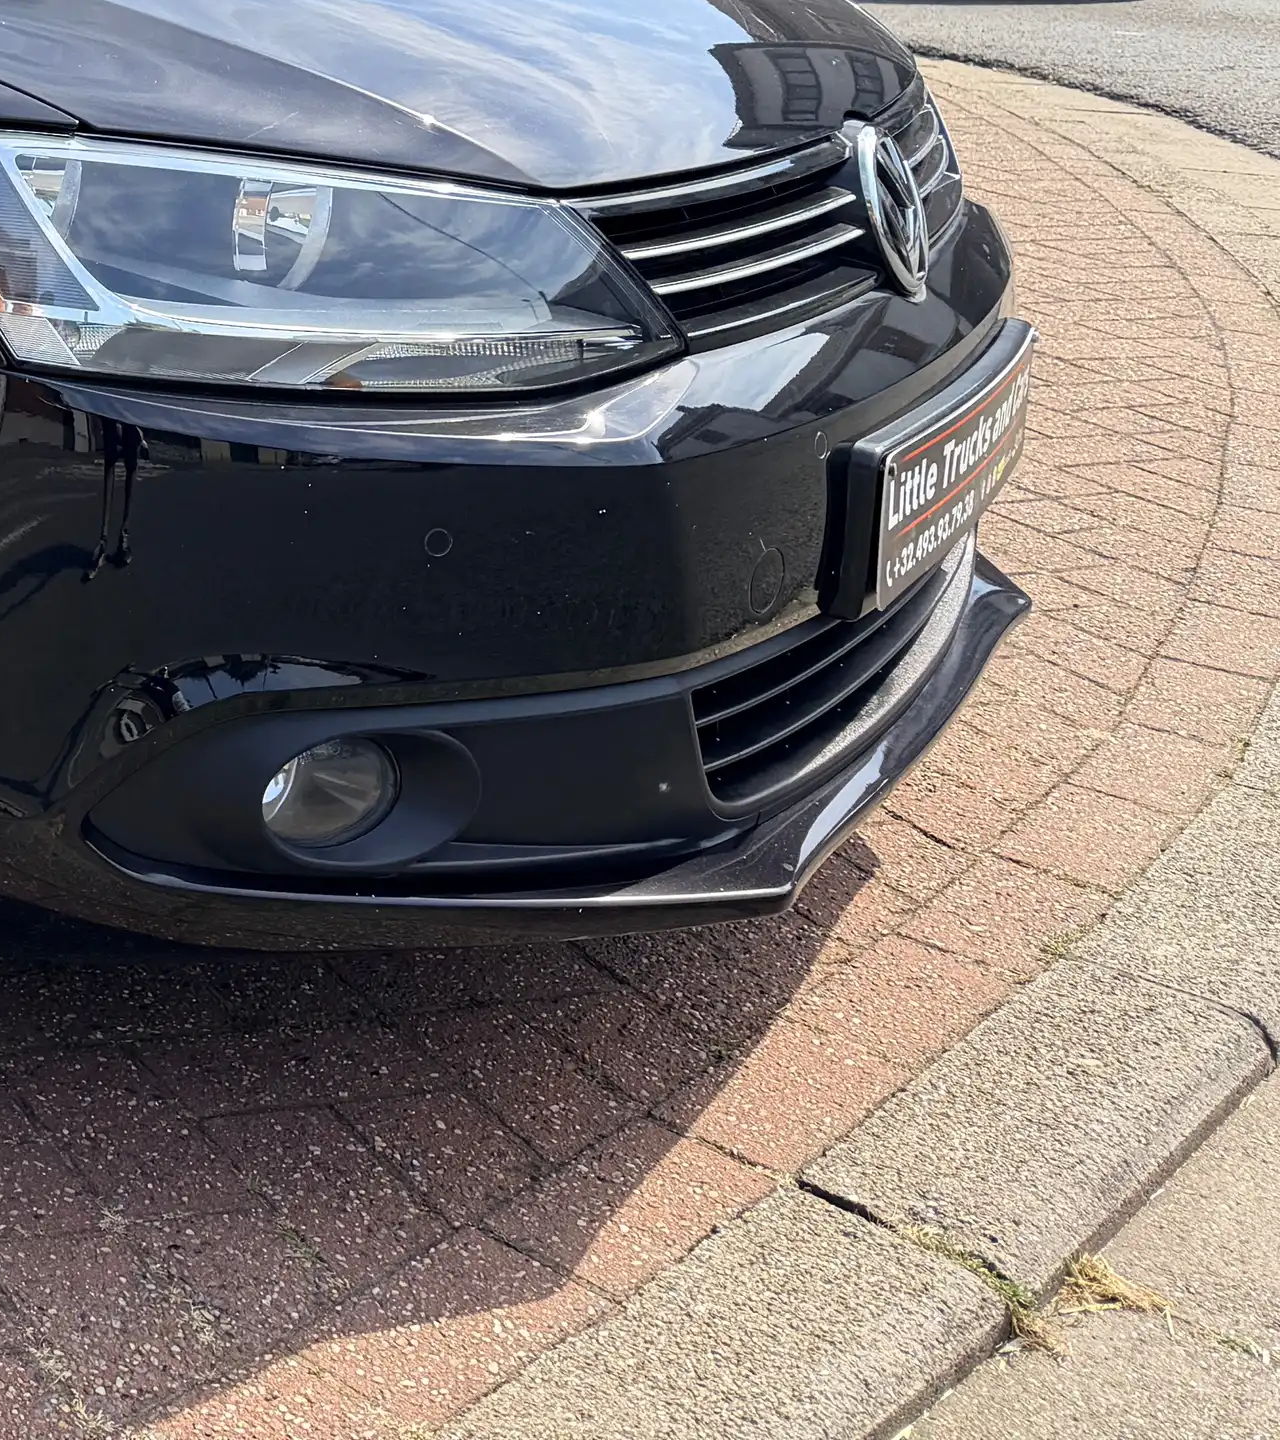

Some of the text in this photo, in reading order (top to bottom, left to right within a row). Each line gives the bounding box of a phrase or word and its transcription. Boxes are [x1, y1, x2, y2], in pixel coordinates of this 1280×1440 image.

[888, 459, 939, 530] Little
[943, 415, 994, 489] Trucks
[992, 382, 1016, 444] and
